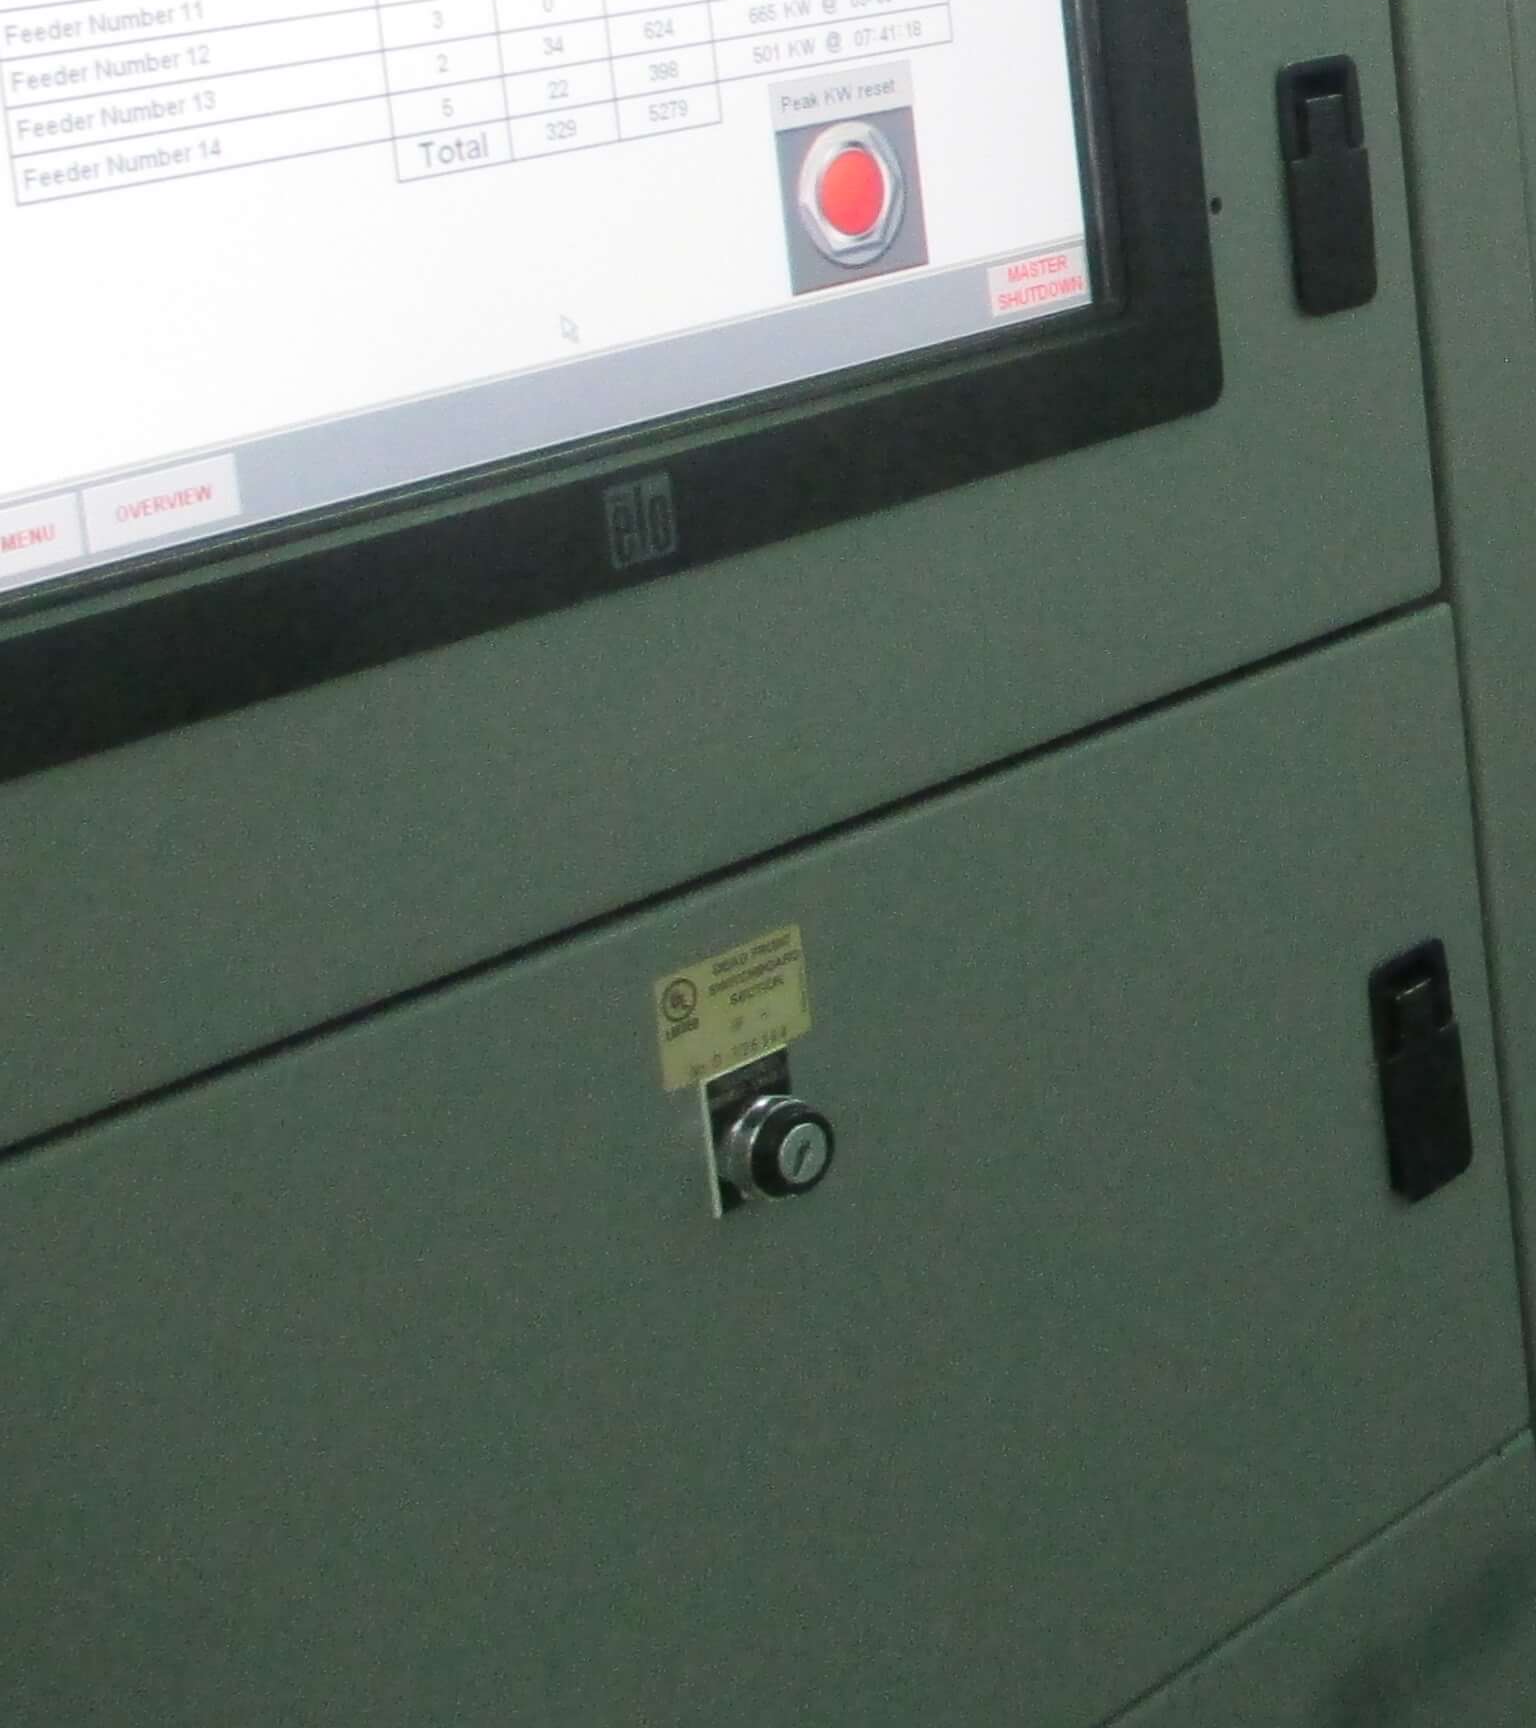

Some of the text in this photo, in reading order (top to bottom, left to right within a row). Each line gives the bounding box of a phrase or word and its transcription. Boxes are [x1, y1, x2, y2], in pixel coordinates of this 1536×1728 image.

[5, 0, 204, 46] Feeder Number 11
[432, 10, 445, 30] 3
[783, 0, 811, 20] KW
[436, 53, 450, 74] 2
[787, 38, 816, 60] KW
[10, 44, 211, 92] Feeder Number 12
[547, 80, 569, 101] 22
[781, 93, 817, 112] Peak
[858, 78, 896, 100] reset
[16, 89, 217, 140] Feeder Number 13
[441, 98, 455, 118] 5
[545, 119, 578, 141] 329
[23, 136, 223, 190] Feeder Number 14
[417, 131, 489, 168] Total
[1007, 255, 1069, 281] MASTER
[997, 274, 1085, 309] SHUTDOWN
[115, 483, 213, 523] OVERVIEW
[0, 522, 56, 553] MENU
